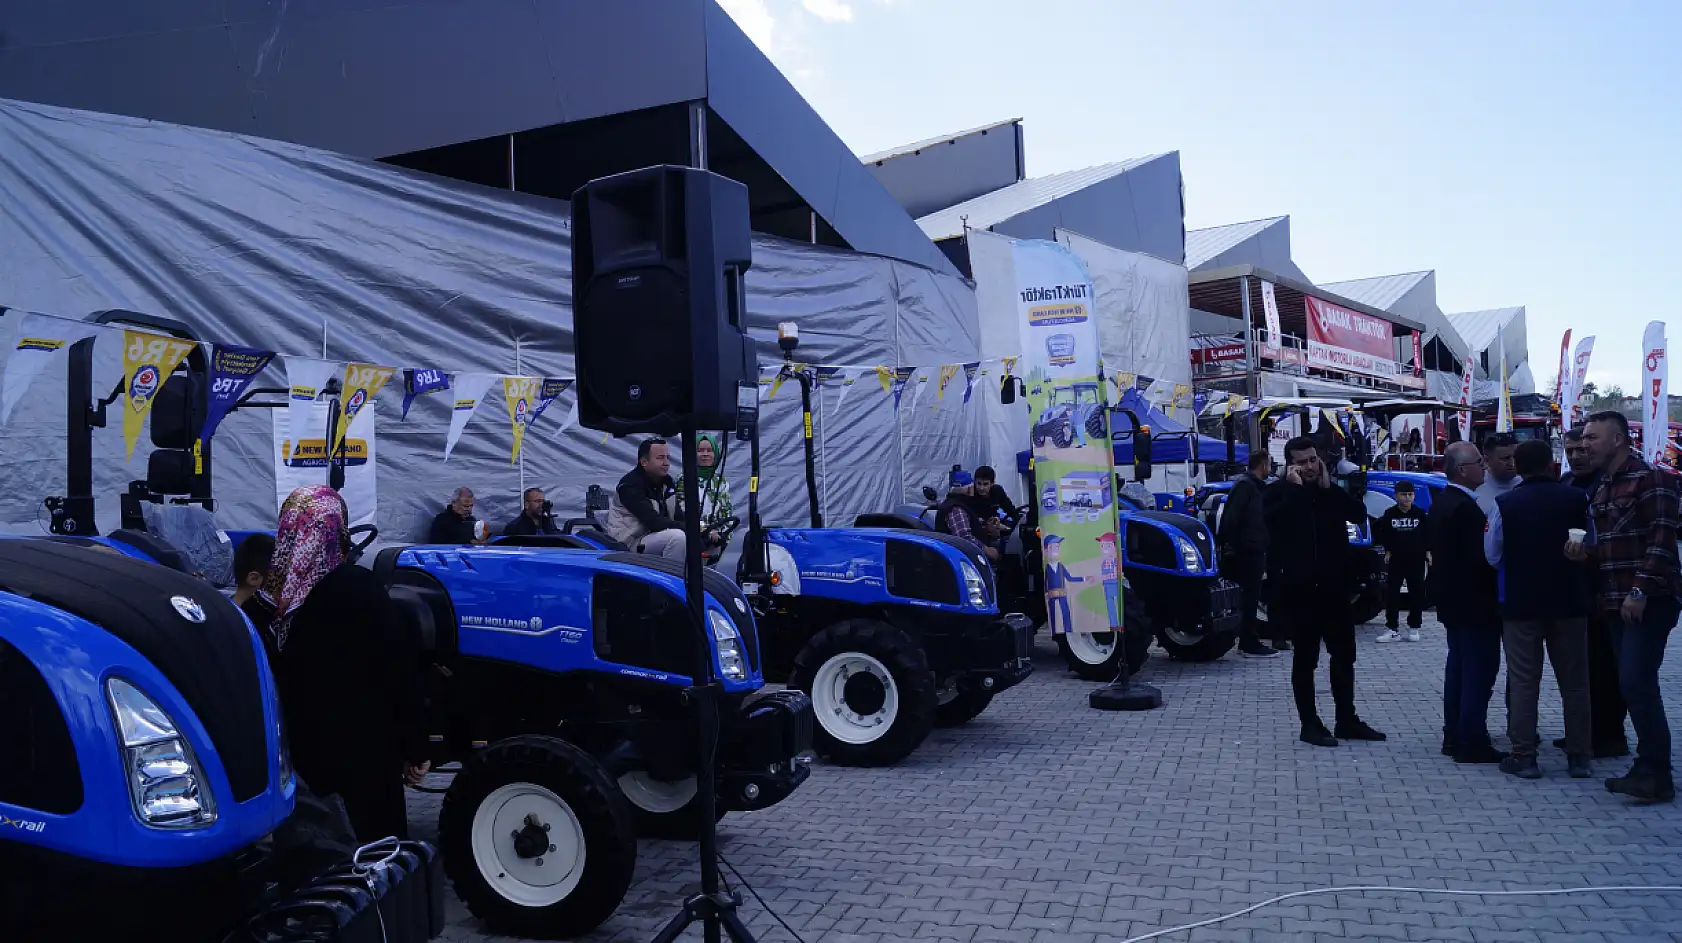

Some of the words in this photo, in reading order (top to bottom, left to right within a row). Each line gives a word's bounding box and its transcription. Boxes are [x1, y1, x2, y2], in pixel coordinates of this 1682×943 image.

[302, 446, 323, 454] NEW
[461, 615, 483, 626] NEW
[485, 617, 528, 629] HOLLAND
